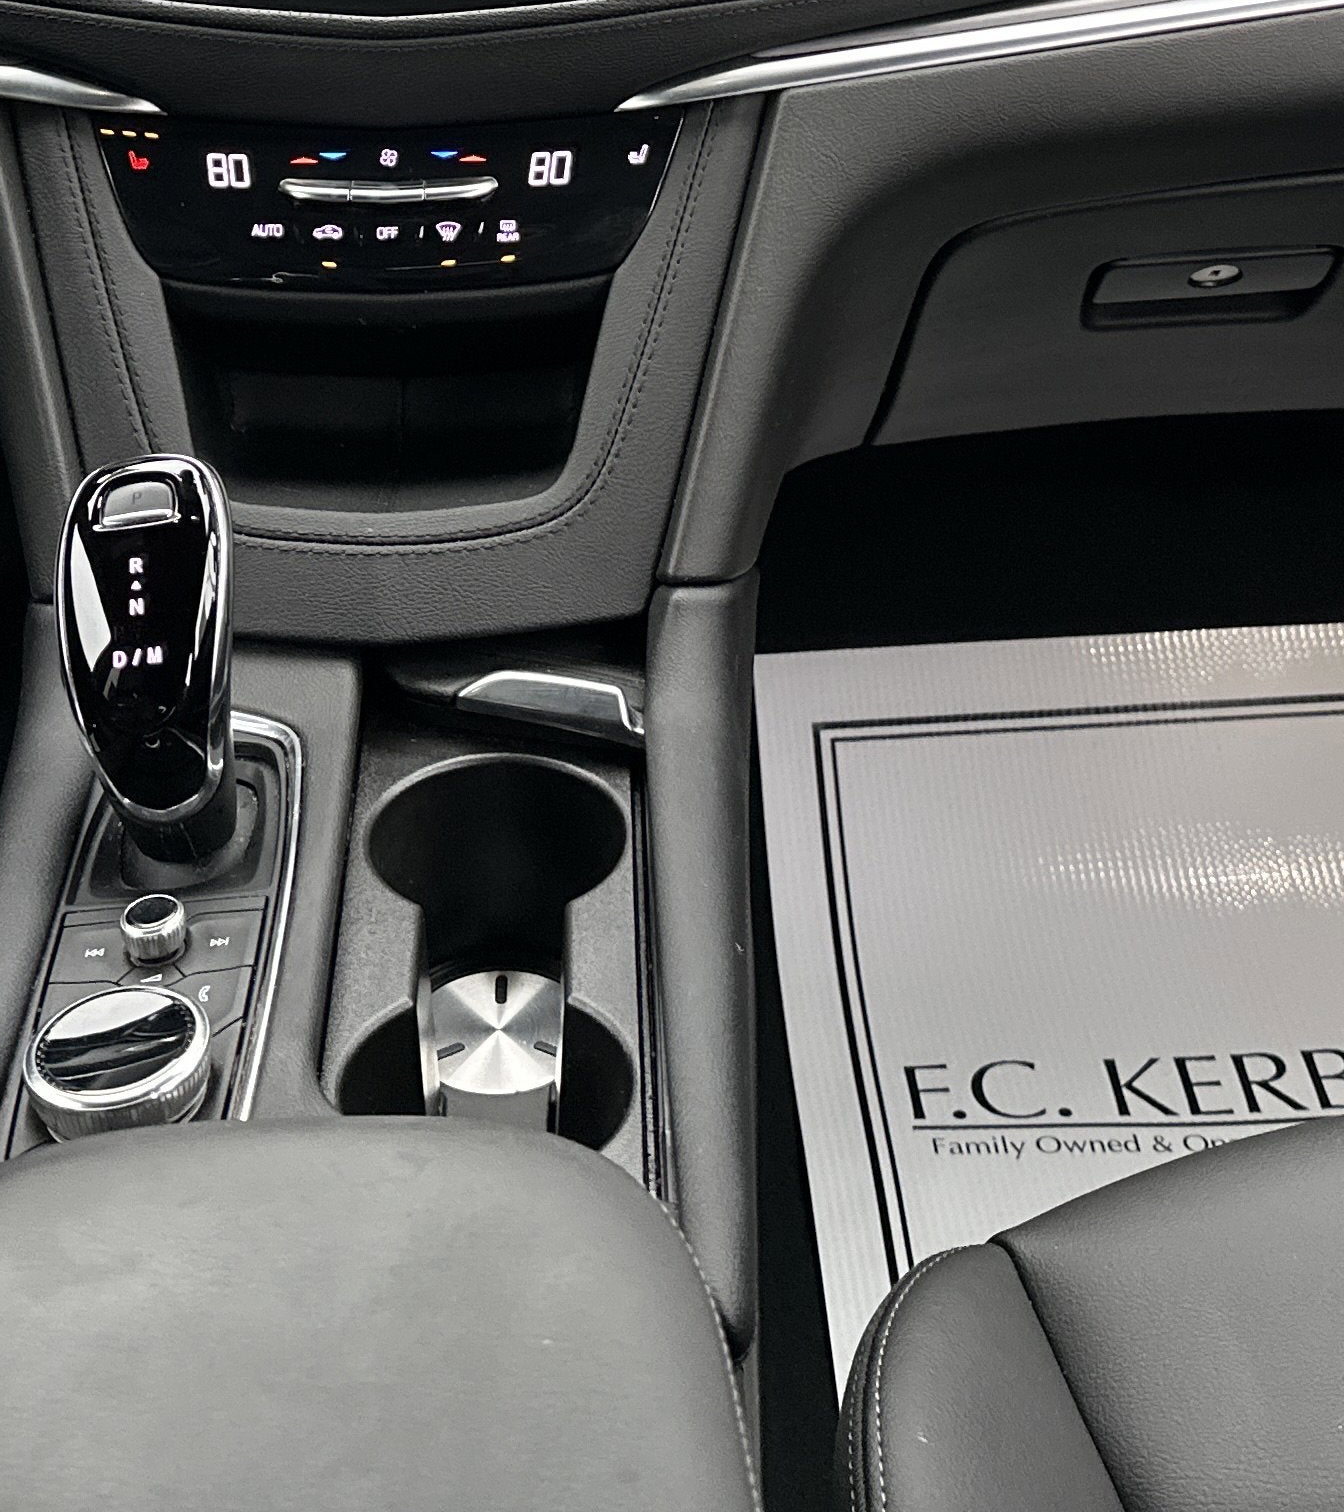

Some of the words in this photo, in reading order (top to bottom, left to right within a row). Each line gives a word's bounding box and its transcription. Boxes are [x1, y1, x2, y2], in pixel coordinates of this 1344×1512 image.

[206, 152, 251, 188] 80
[528, 150, 572, 186] 80
[251, 223, 284, 238] AUTO
[376, 225, 399, 240] OFF
[496, 231, 520, 242] REAR
[131, 490, 143, 507] P
[128, 557, 143, 574] R
[128, 598, 144, 616] N
[902, 1059, 1073, 1120] F.C.
[932, 1134, 1025, 1160] Family
[1036, 1134, 1141, 1154] Owned
[1152, 1135, 1174, 1153] &
